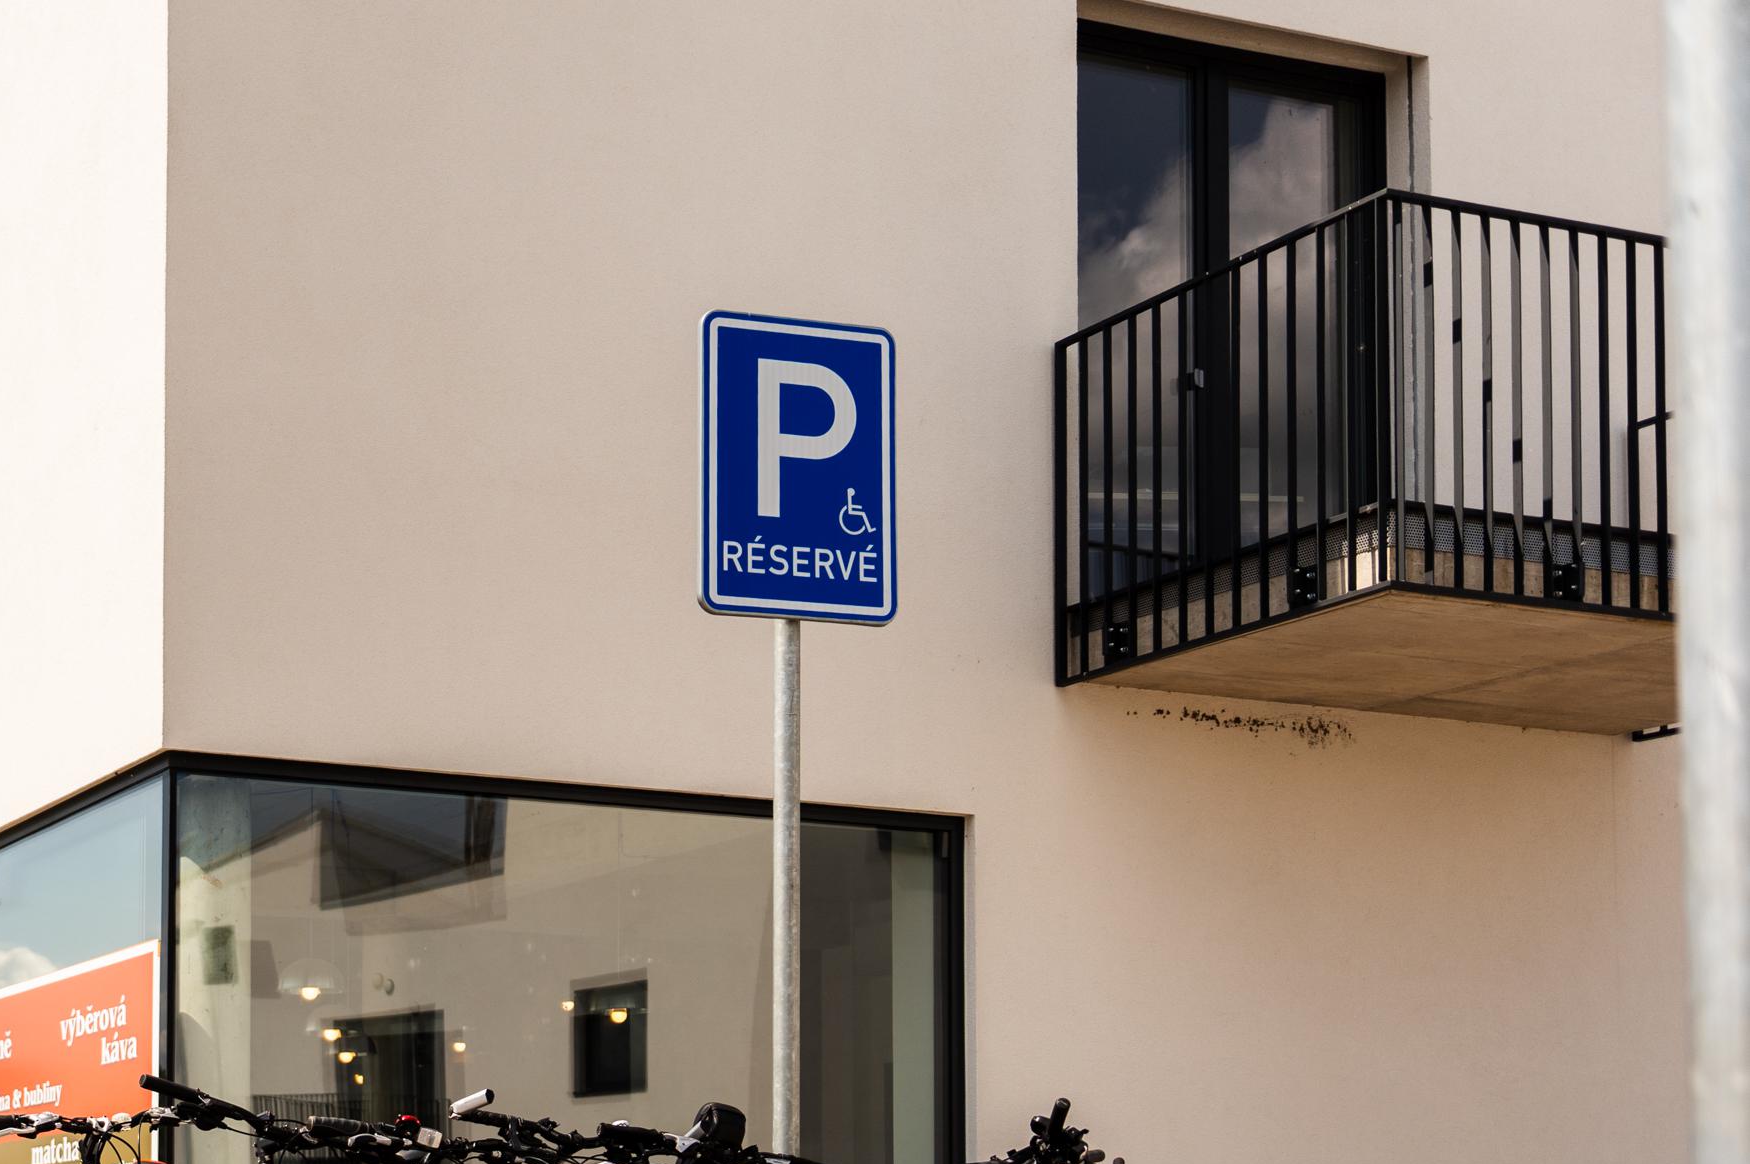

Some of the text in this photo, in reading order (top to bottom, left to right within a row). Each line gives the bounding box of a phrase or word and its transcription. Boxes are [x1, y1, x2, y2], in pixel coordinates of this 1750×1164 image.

[757, 357, 858, 518] P
[722, 535, 878, 583] RÉSERVÉ
[60, 994, 127, 1047] výběrová
[101, 1032, 137, 1065] káva
[12, 1088, 22, 1109] &
[23, 1080, 62, 1107] bubliny
